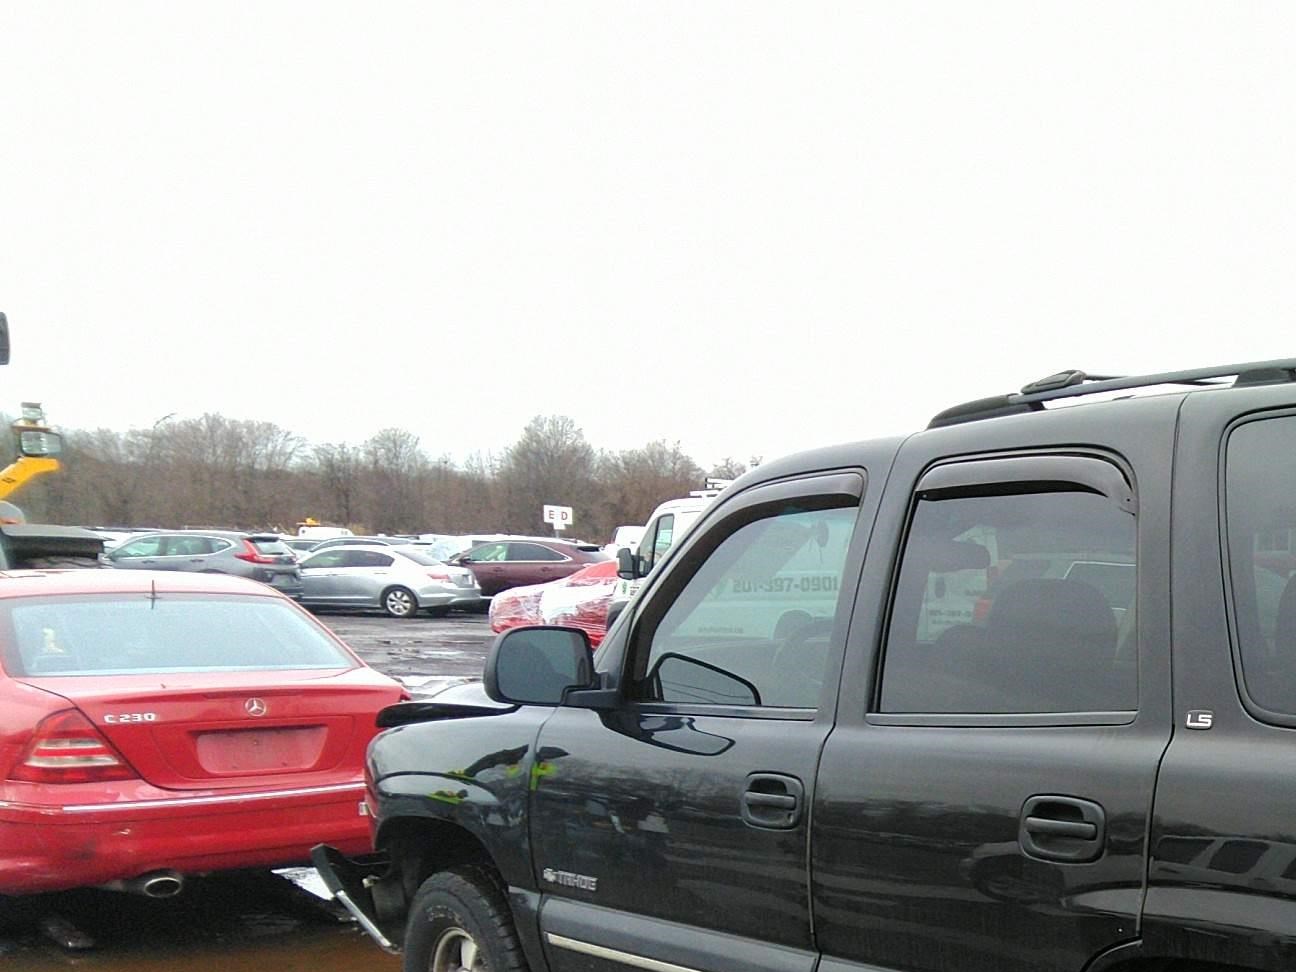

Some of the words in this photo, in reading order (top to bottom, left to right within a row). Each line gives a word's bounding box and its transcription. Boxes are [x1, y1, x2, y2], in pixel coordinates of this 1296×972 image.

[103, 714, 117, 724] C
[119, 713, 156, 723] 230
[1186, 713, 1213, 728] LS
